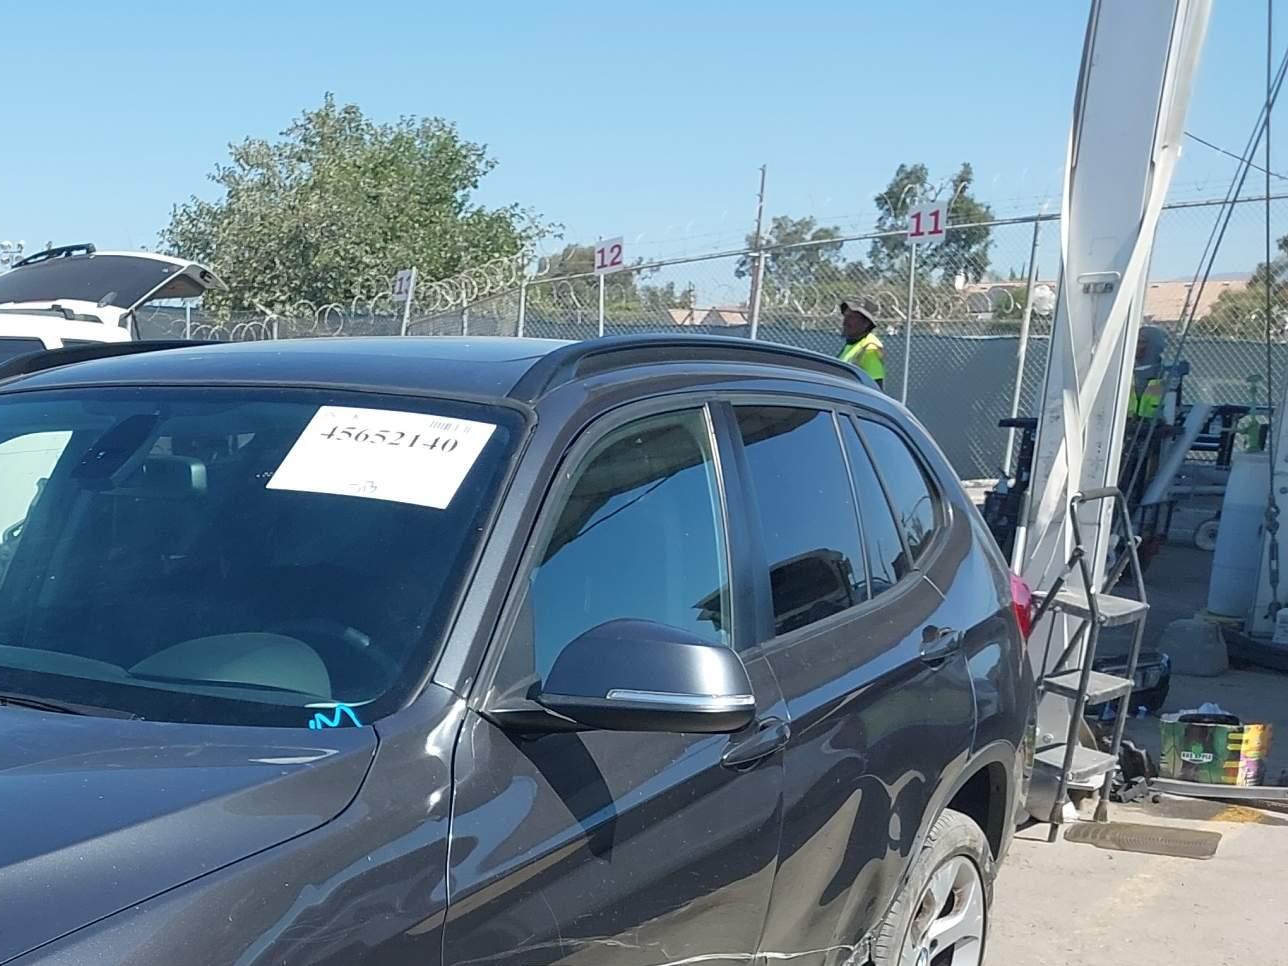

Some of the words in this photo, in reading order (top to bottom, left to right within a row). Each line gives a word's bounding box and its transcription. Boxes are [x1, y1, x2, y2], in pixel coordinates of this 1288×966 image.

[909, 209, 943, 237] 11
[596, 244, 622, 269] 12
[320, 425, 459, 453] 45652140
